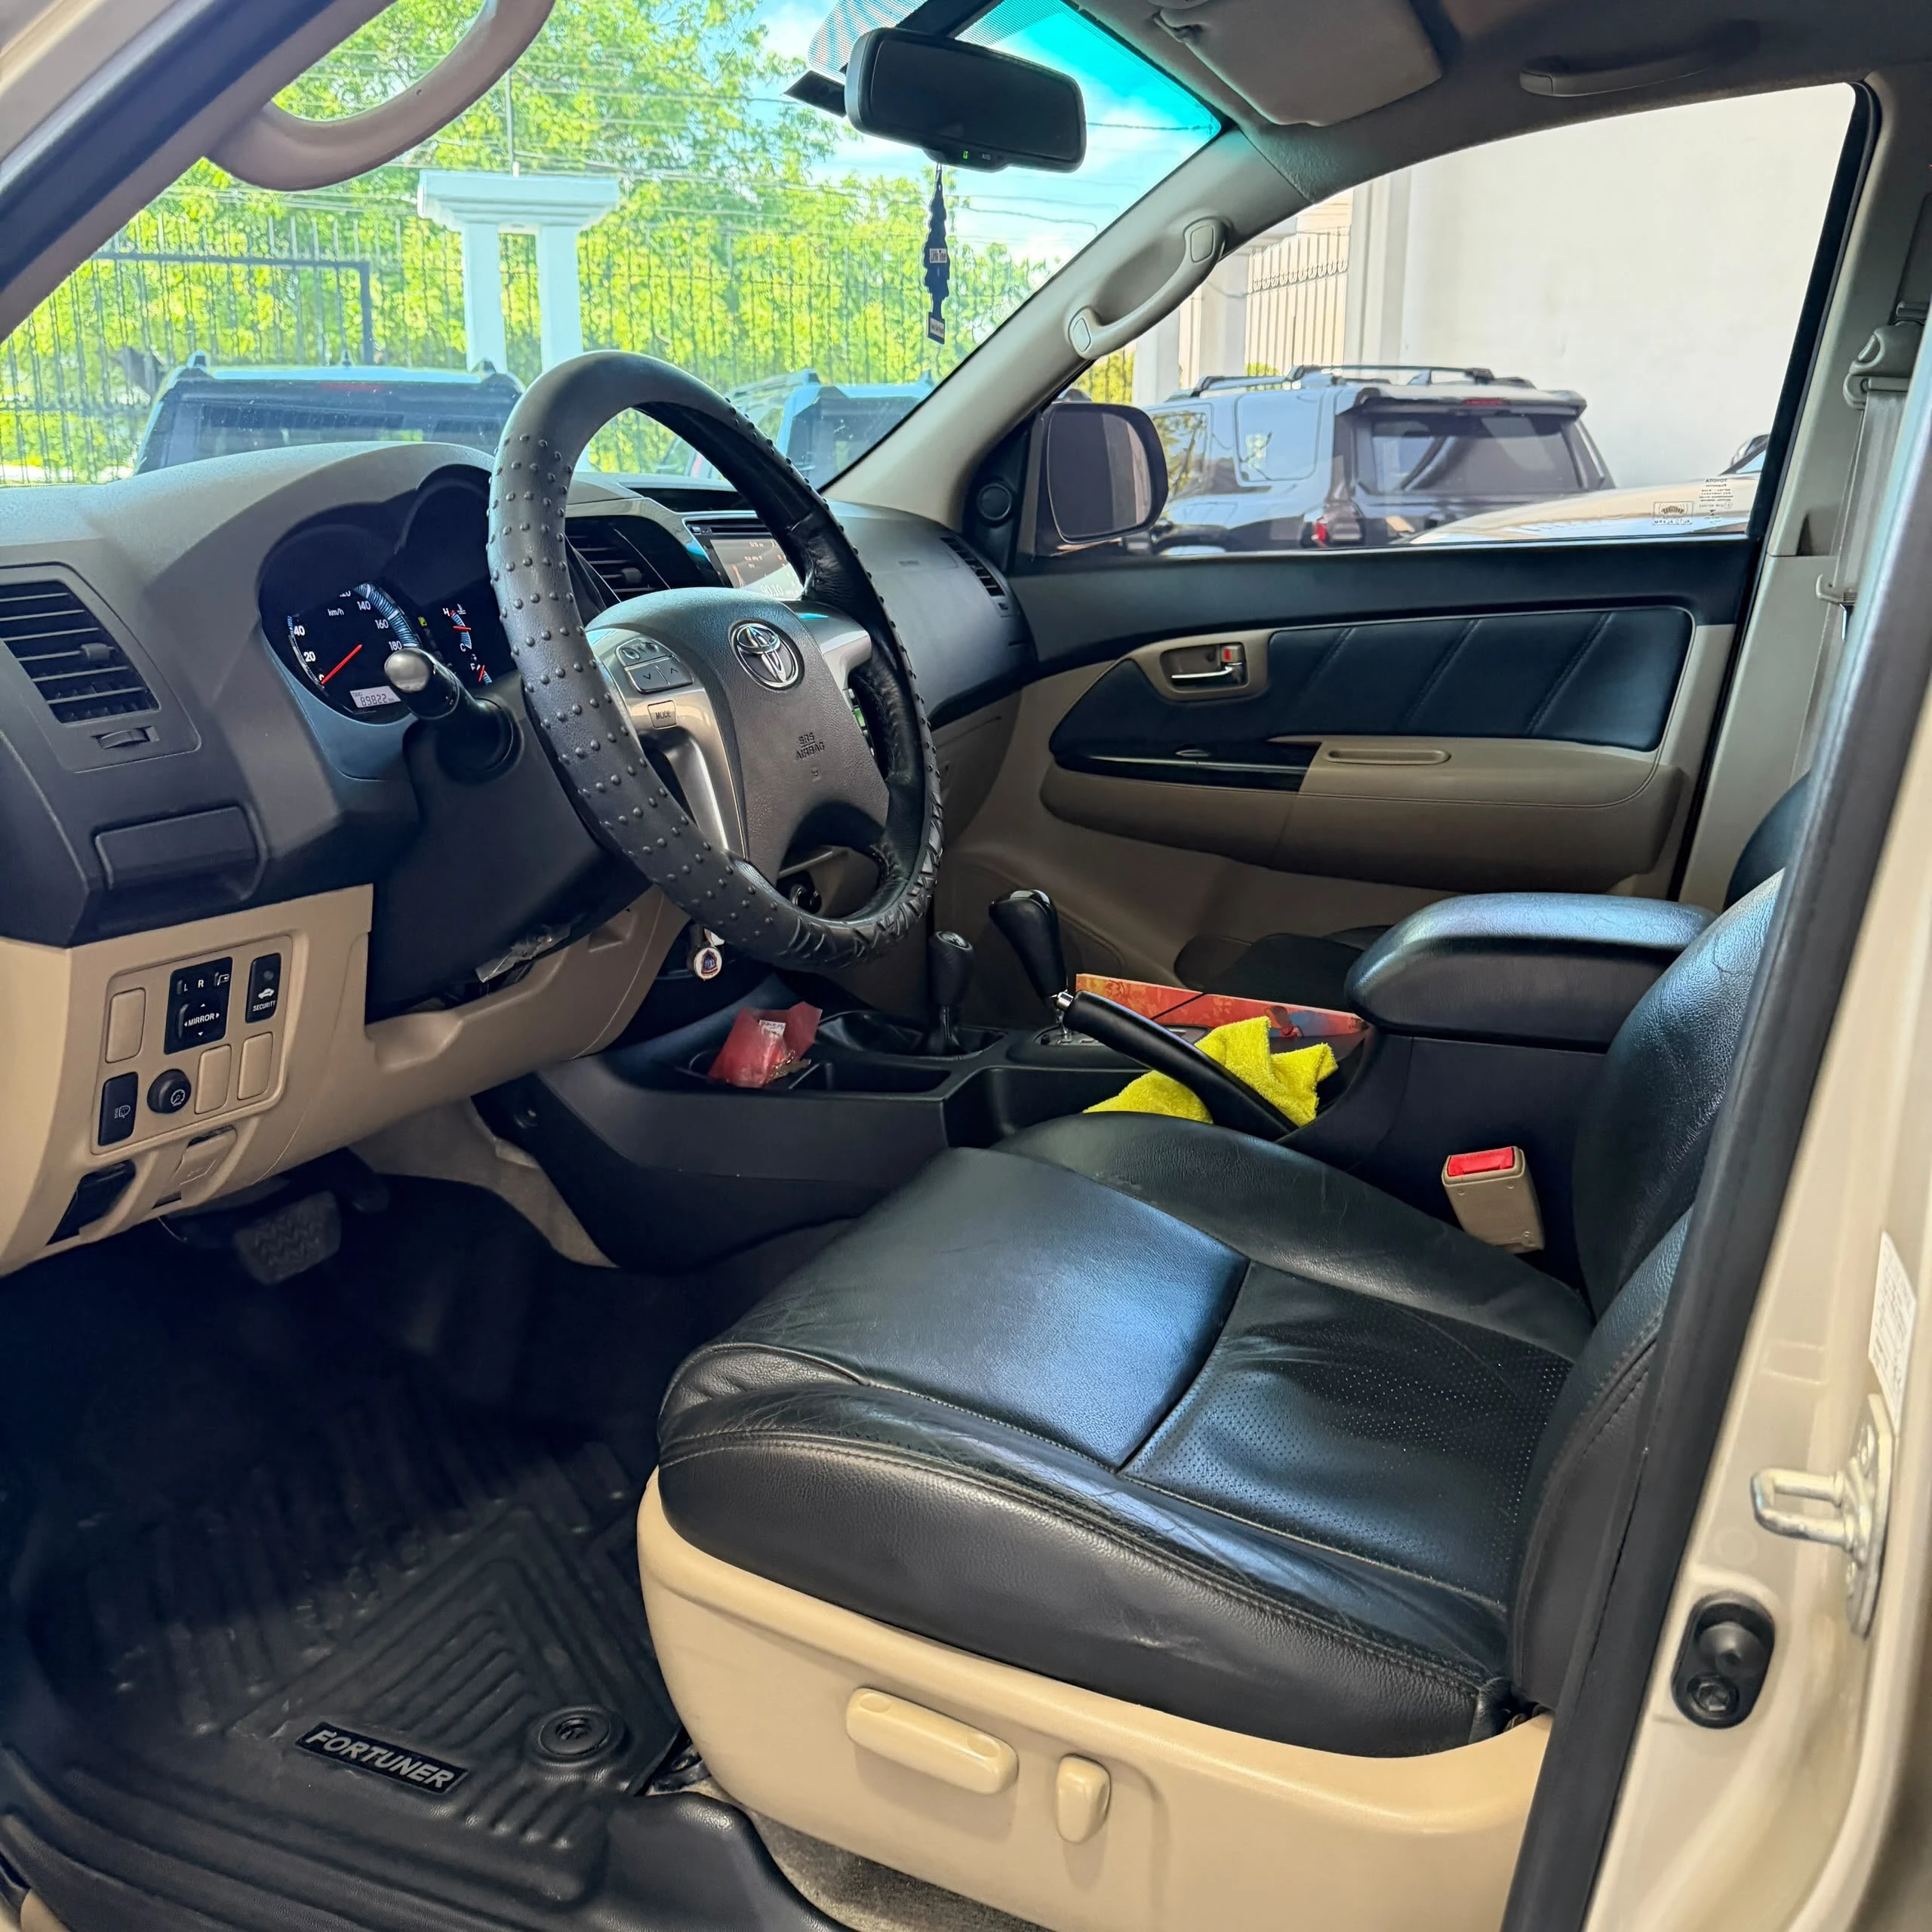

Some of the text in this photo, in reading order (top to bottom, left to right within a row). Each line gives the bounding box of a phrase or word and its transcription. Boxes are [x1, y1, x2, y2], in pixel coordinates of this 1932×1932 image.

[357, 601, 371, 611] 140
[328, 608, 344, 617] km/h
[442, 608, 451, 617] H
[375, 619, 389, 629] 160
[294, 625, 306, 636] 40
[388, 640, 402, 651] 180
[460, 643, 466, 652] C
[303, 651, 316, 662] 20
[360, 694, 387, 706] 89822
[655, 710, 671, 720] MODE
[798, 732, 815, 744] SRS
[796, 741, 825, 760] AIRBAG
[183, 980, 205, 992] L R
[253, 1000, 276, 1011] SECURITY
[188, 1013, 214, 1026] MIRROR
[306, 1730, 454, 1788] FORTUNER
